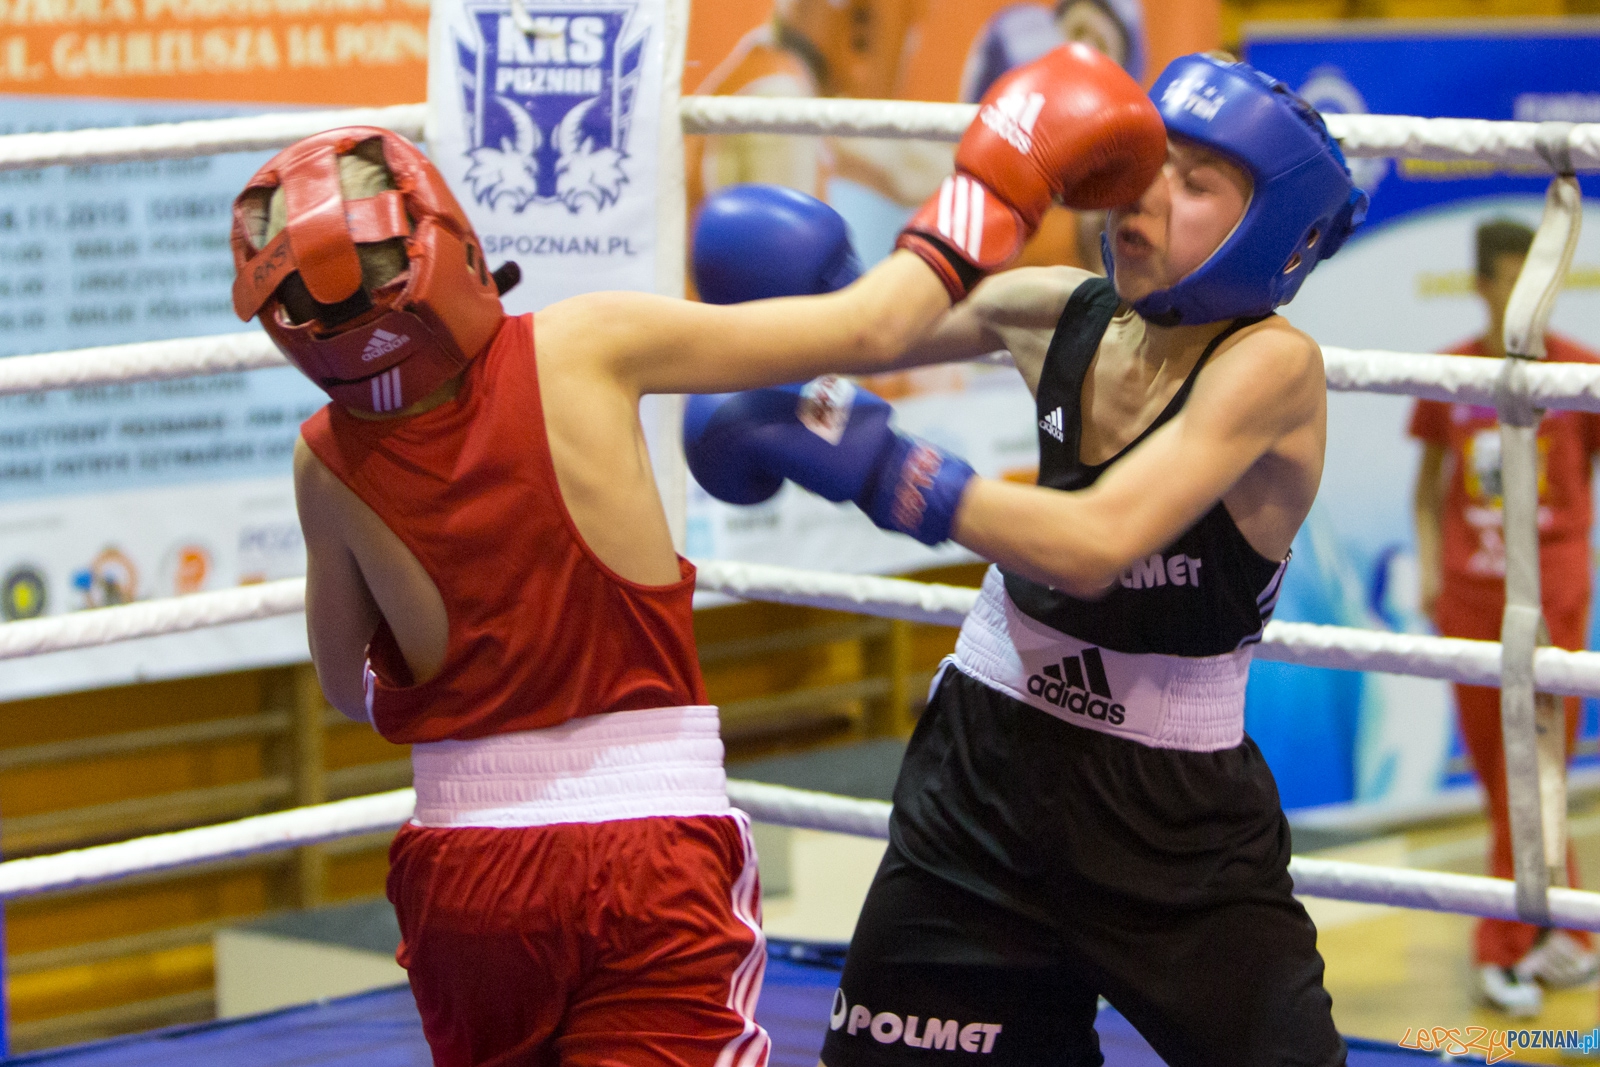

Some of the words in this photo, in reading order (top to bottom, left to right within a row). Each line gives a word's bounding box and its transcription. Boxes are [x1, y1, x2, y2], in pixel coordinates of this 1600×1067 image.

[498, 16, 605, 63] KKS
[484, 235, 637, 255] SPOZNAN.PL
[1119, 553, 1202, 590] LMET
[1027, 674, 1126, 725] adidas
[847, 1004, 1003, 1054] POLMET
